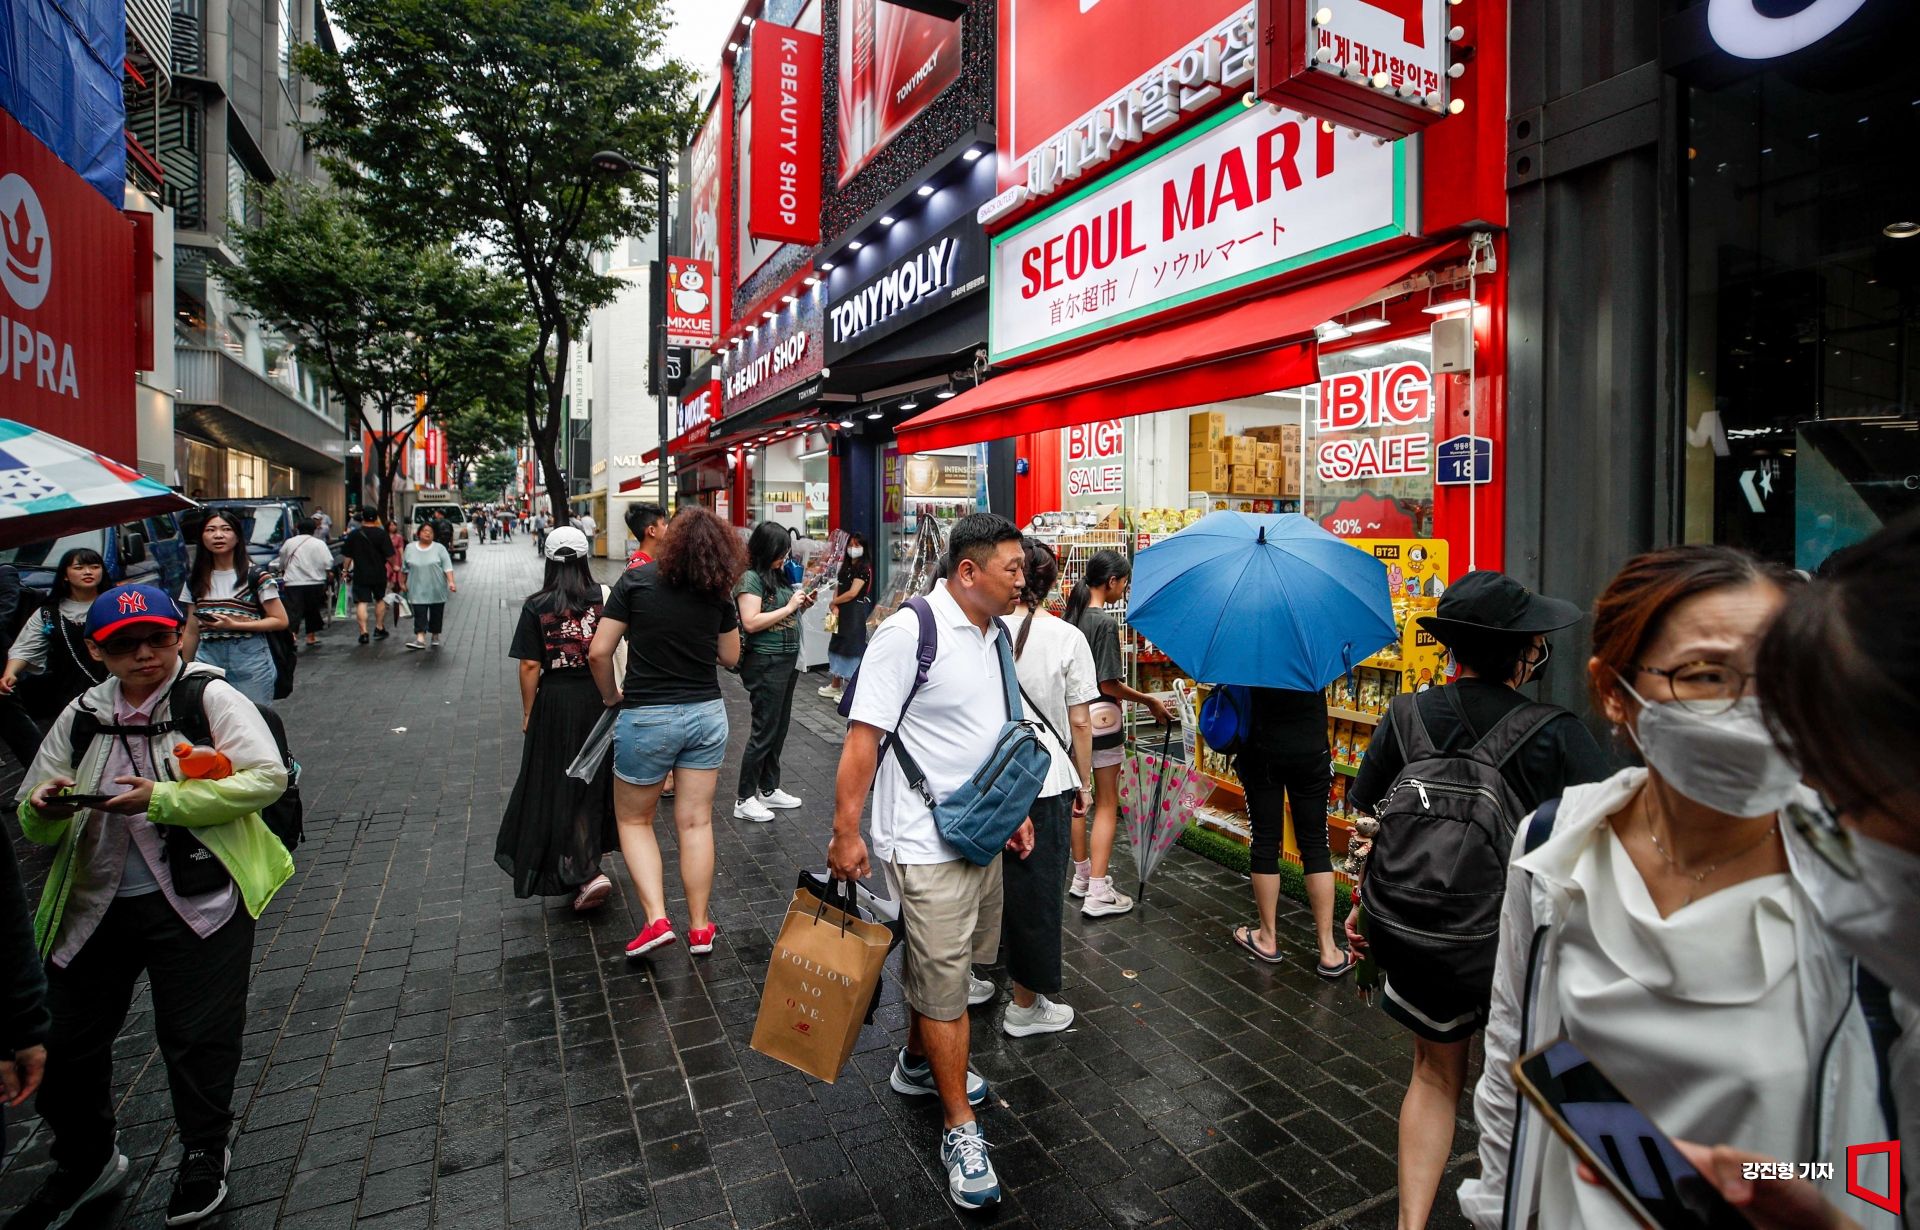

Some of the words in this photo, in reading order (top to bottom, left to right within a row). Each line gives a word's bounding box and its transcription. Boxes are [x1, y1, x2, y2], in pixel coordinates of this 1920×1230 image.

[896, 47, 940, 104] TONYMOLY
[1317, 28, 1438, 98] 세계과자할인점
[780, 37, 798, 156] K-BEAUTY
[1024, 9, 1255, 200] 세계과자할인점
[779, 161, 797, 225] SHOP
[1021, 201, 1146, 301] SEOUL
[1162, 117, 1336, 243] MART
[830, 237, 956, 344] TONYMOLY
[1048, 277, 1117, 327] 首尔超市
[1152, 217, 1287, 288] ソウルマート
[667, 316, 711, 331] MIXUE
[726, 351, 771, 400] K-BEAUTY
[773, 331, 807, 374] SHOP
[576, 377, 584, 416] REPUBLIC
[684, 390, 711, 431] MIXUE
[1320, 363, 1430, 431] BIG
[1069, 419, 1118, 459] BIG
[1320, 434, 1430, 481] SALE
[1069, 466, 1120, 495] SALE
[1452, 460, 1473, 478] 18
[1332, 518, 1362, 535] 30%
[1375, 546, 1399, 558] BT21
[781, 949, 854, 988] FOLLOW
[800, 981, 823, 998] NO
[786, 997, 825, 1022] ONE.
